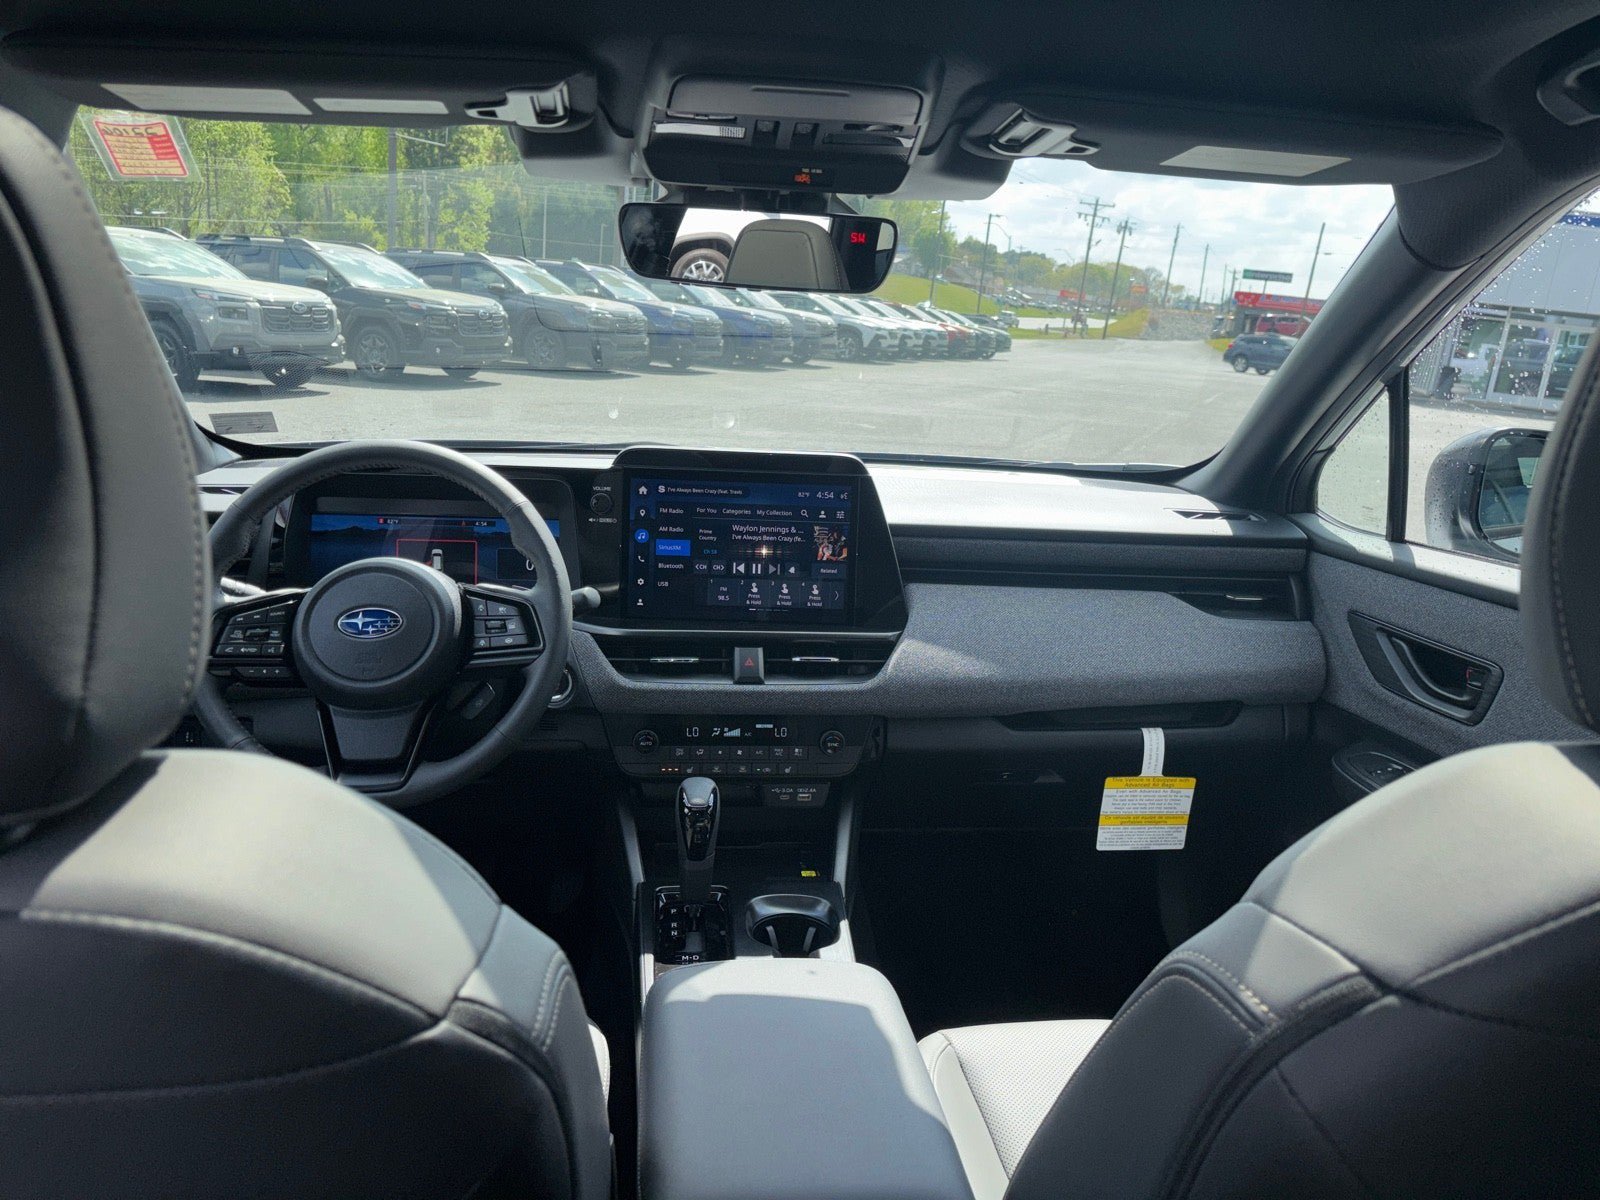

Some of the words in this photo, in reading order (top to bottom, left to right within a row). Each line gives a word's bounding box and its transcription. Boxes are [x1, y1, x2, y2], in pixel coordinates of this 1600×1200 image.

[850, 233, 865, 243] SW
[816, 491, 834, 499] 4:54
[732, 525, 758, 534] Waylon
[759, 525, 789, 534] Jennings
[686, 727, 699, 737] LO
[774, 727, 787, 737] LO
